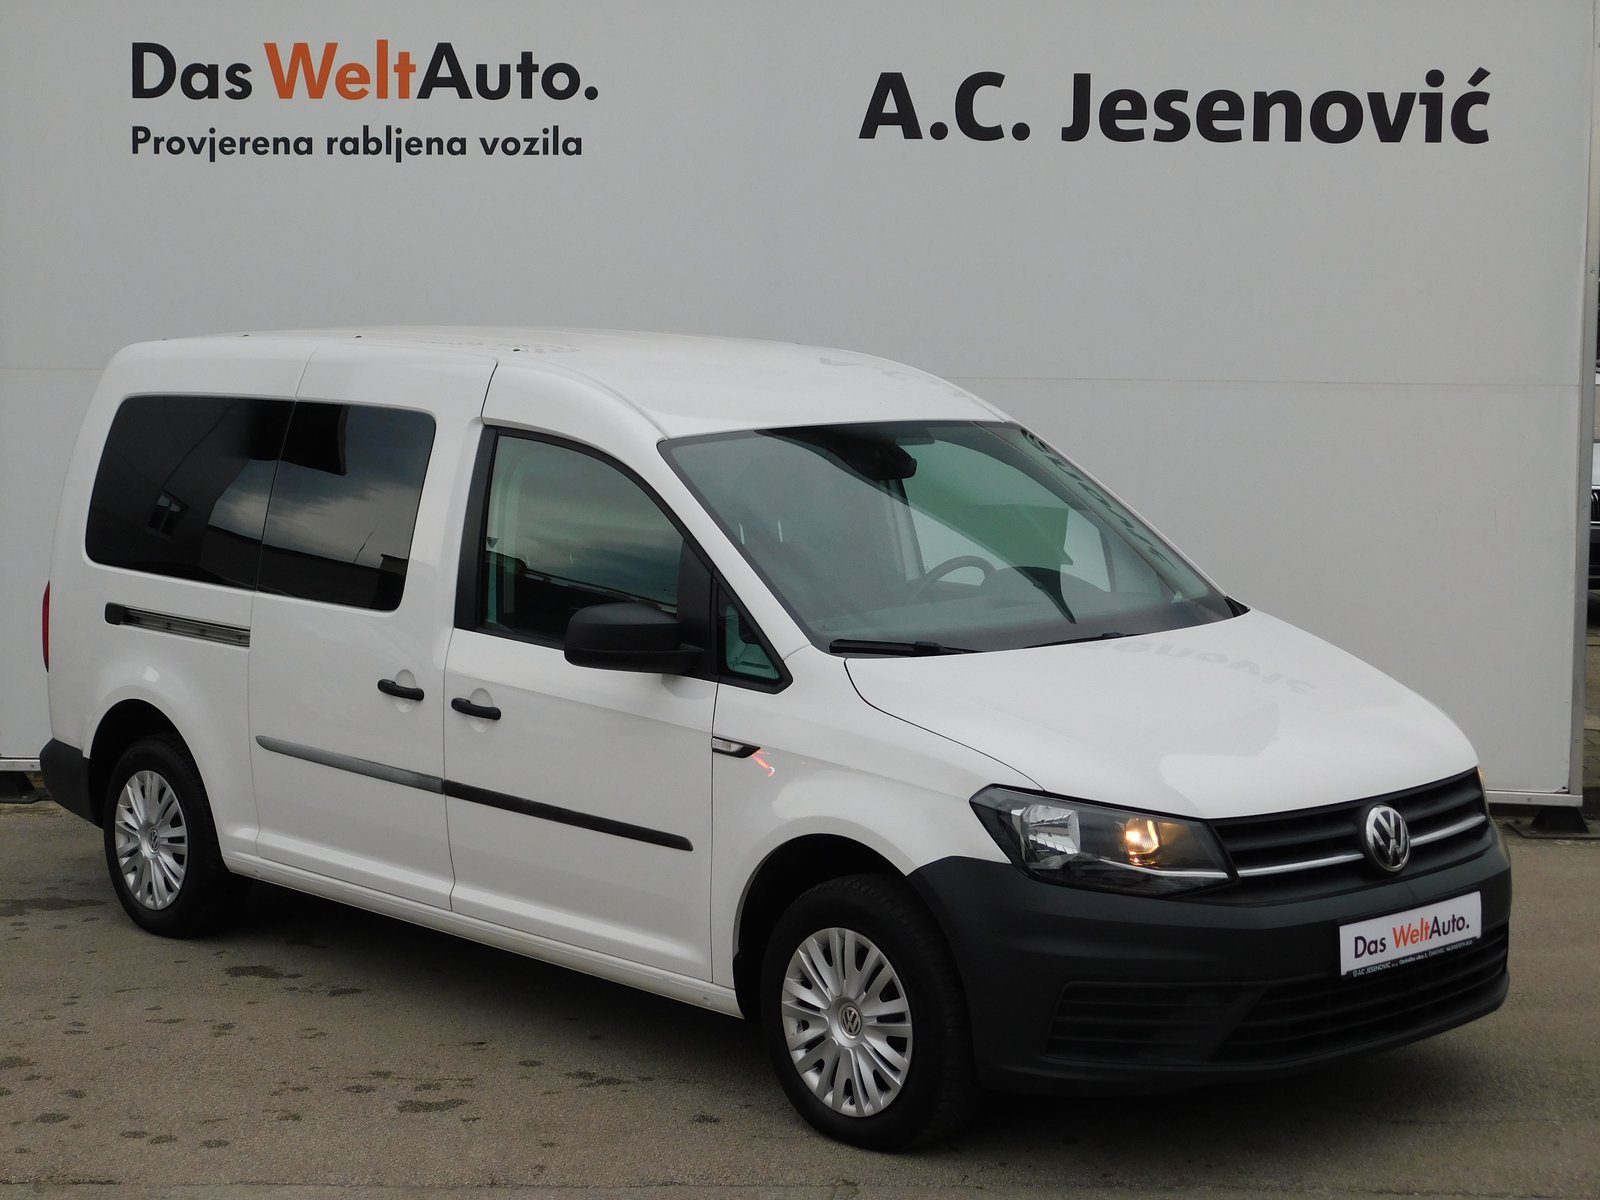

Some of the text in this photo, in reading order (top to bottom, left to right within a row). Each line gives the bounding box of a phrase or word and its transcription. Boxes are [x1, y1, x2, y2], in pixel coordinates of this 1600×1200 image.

[132, 40, 598, 100] Das WeltAuto.
[859, 67, 1491, 144] A.C. Jesenović
[132, 125, 581, 163] Provjerena rabljena vozila
[1354, 936, 1387, 959] Das
[1392, 914, 1470, 949] WeltAuto.
